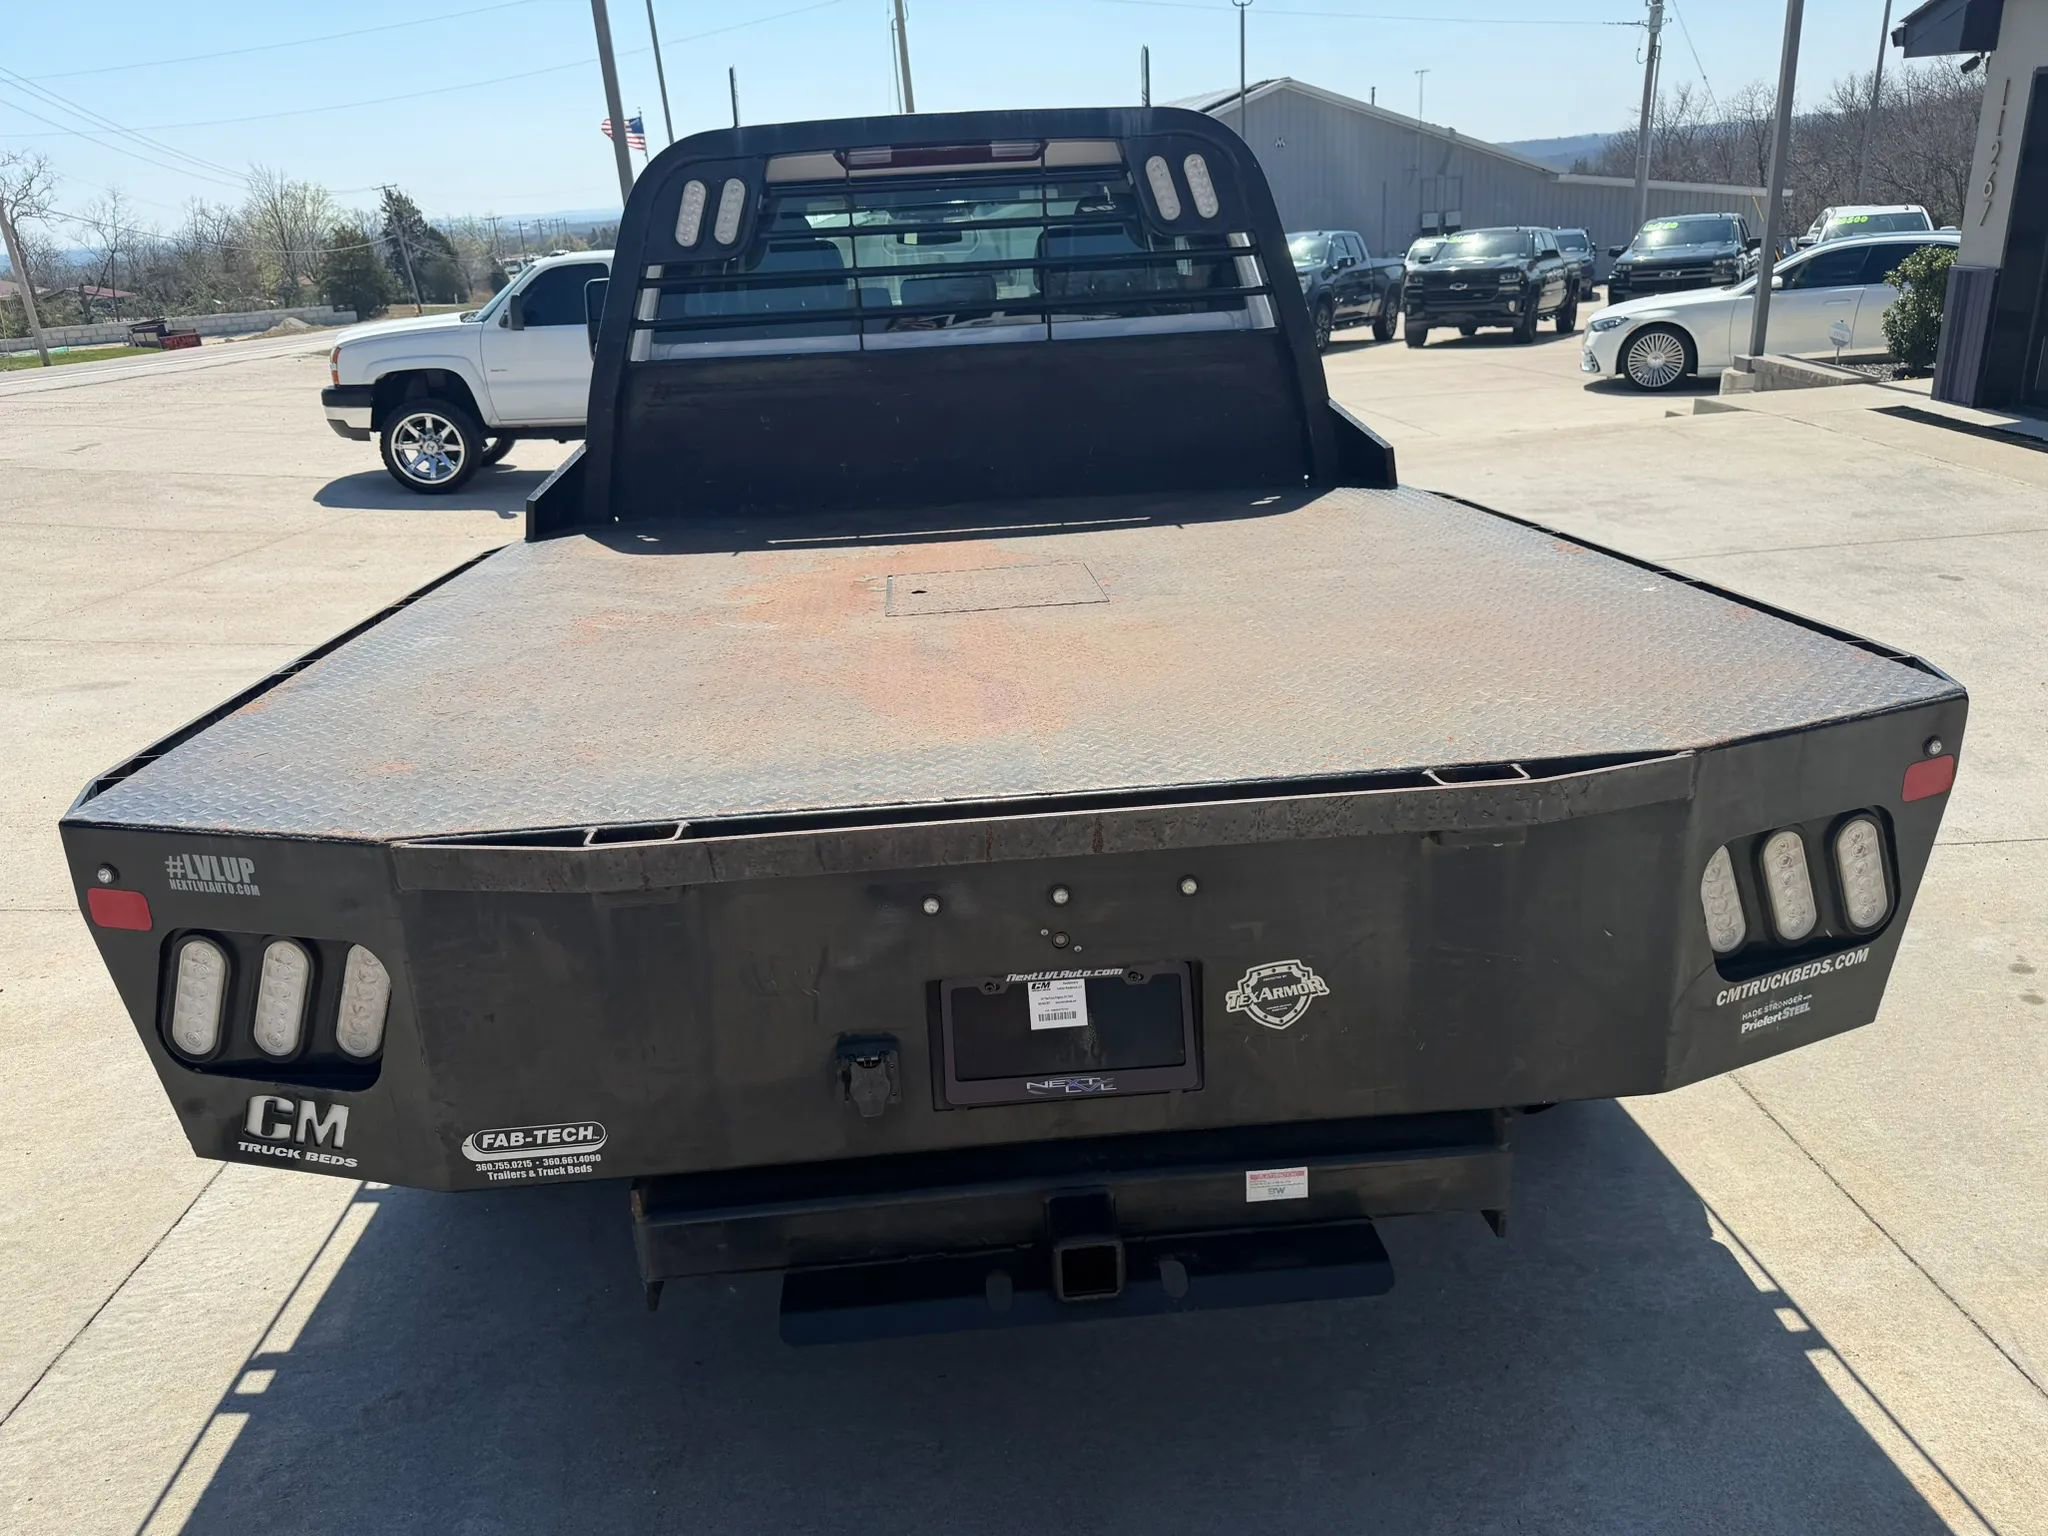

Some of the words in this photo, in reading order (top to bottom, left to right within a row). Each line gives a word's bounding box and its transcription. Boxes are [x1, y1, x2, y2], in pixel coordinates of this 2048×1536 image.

[164, 853, 255, 883] #LVLUP
[168, 878, 260, 896] NEXTLVLAUTO.COM
[1716, 947, 1870, 1006] CMTRUCKBEDS.COM
[1742, 1007, 1763, 1020] MADE
[1764, 993, 1803, 1013] STRONGER
[245, 1095, 349, 1148] CM
[482, 1125, 594, 1149] FAB-TECH
[238, 1141, 302, 1160] TRUCK
[305, 1151, 359, 1168] BEDS
[475, 1160, 533, 1172] 360.755.0215
[542, 1153, 602, 1167] 360.661.4090
[487, 1168, 527, 1181] Trailers
[528, 1168, 537, 1178] &
[538, 1167, 566, 1177] Truck
[567, 1163, 593, 1175] Beds
